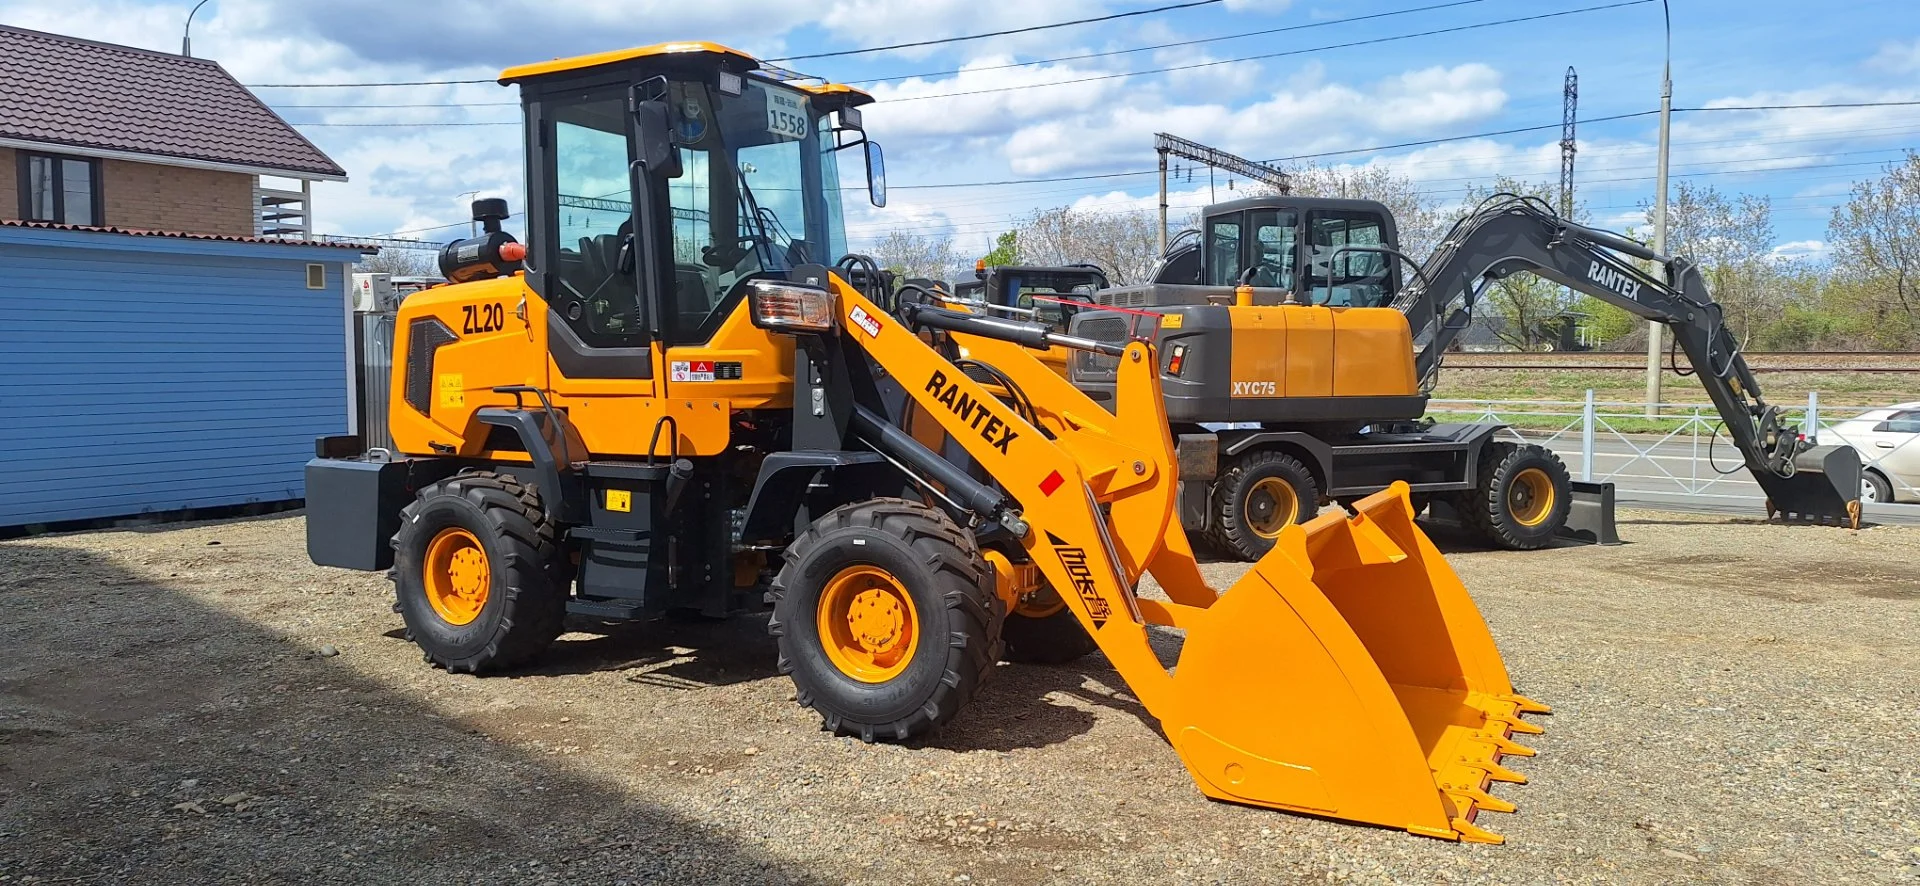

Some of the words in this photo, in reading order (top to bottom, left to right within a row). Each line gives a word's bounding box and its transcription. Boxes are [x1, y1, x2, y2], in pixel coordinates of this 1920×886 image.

[770, 109, 805, 136] 1558
[1587, 260, 1642, 301] RANTEX
[462, 302, 504, 335] ZL20
[1233, 381, 1276, 395] XYC75
[925, 369, 1019, 456] RANTEX
